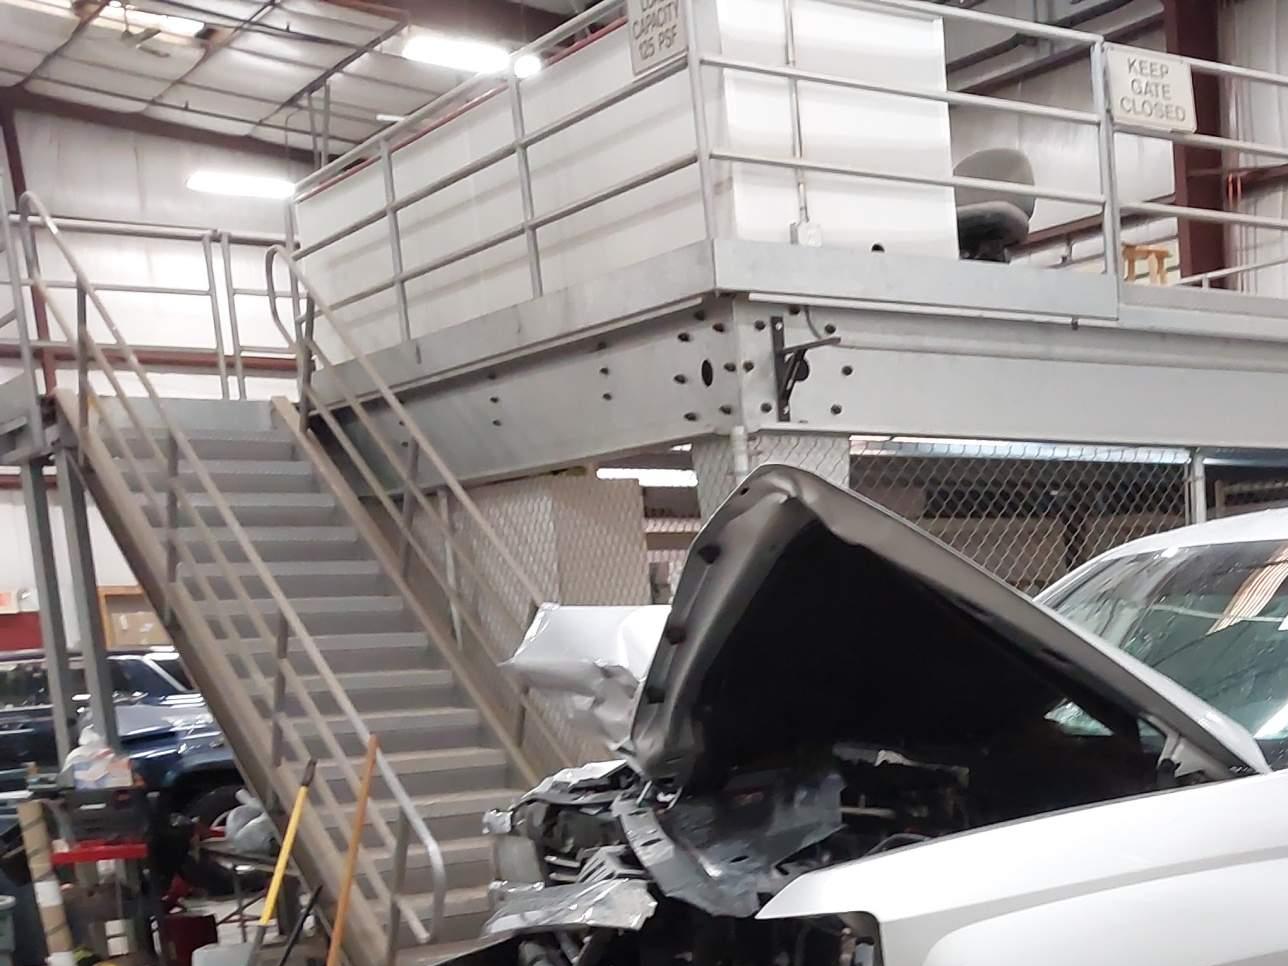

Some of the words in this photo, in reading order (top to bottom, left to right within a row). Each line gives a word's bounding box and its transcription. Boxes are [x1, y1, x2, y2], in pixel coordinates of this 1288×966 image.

[633, 0, 679, 40] CAPACITY
[639, 36, 655, 60] 125
[658, 24, 678, 50] PSF
[1128, 56, 1168, 78] KEEP
[1131, 78, 1171, 101] GATE
[1120, 96, 1185, 121] CLOSED
